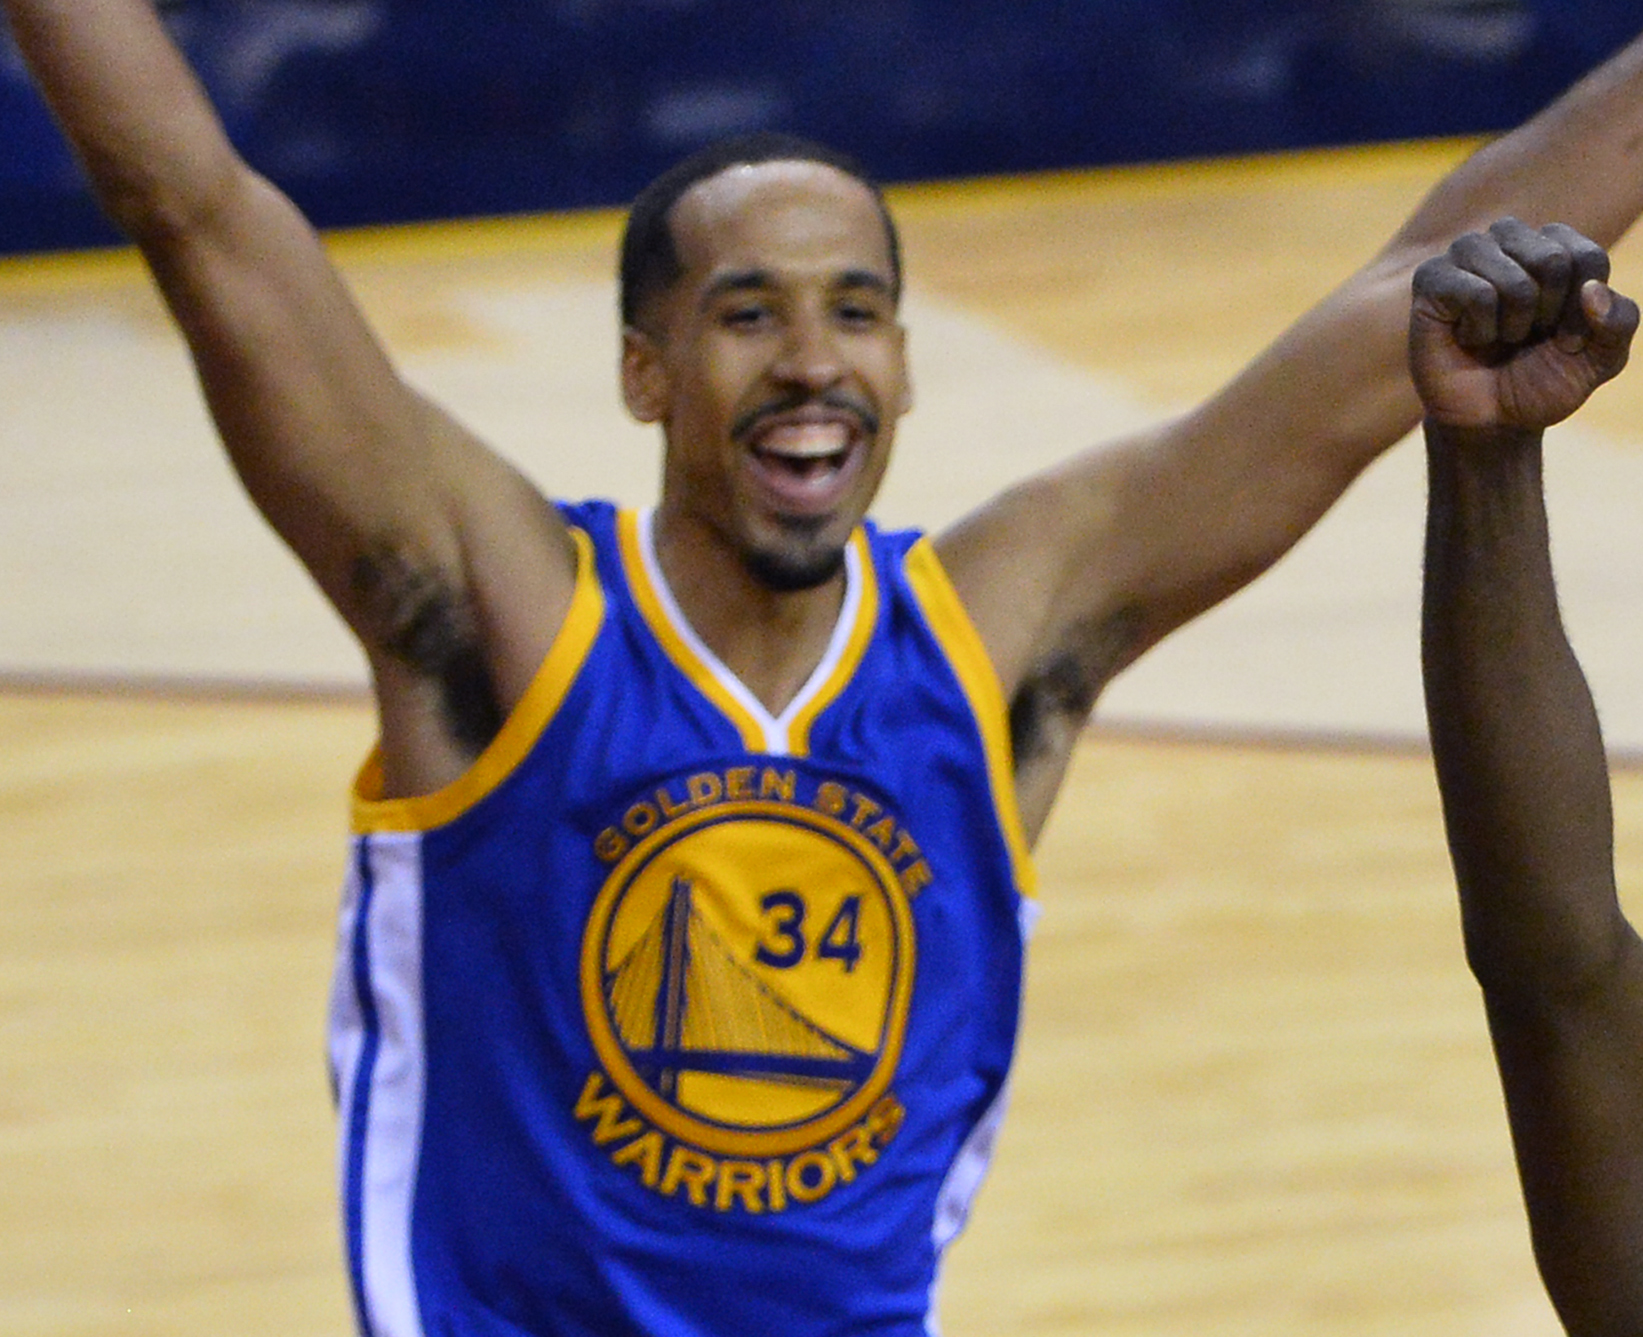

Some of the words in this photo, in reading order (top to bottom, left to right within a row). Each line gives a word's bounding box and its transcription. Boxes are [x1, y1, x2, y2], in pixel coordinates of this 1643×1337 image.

[593, 766, 797, 863] GOLDEN
[816, 781, 934, 897] STATE
[753, 891, 864, 974] 34
[573, 1071, 906, 1215] WARRIORS
